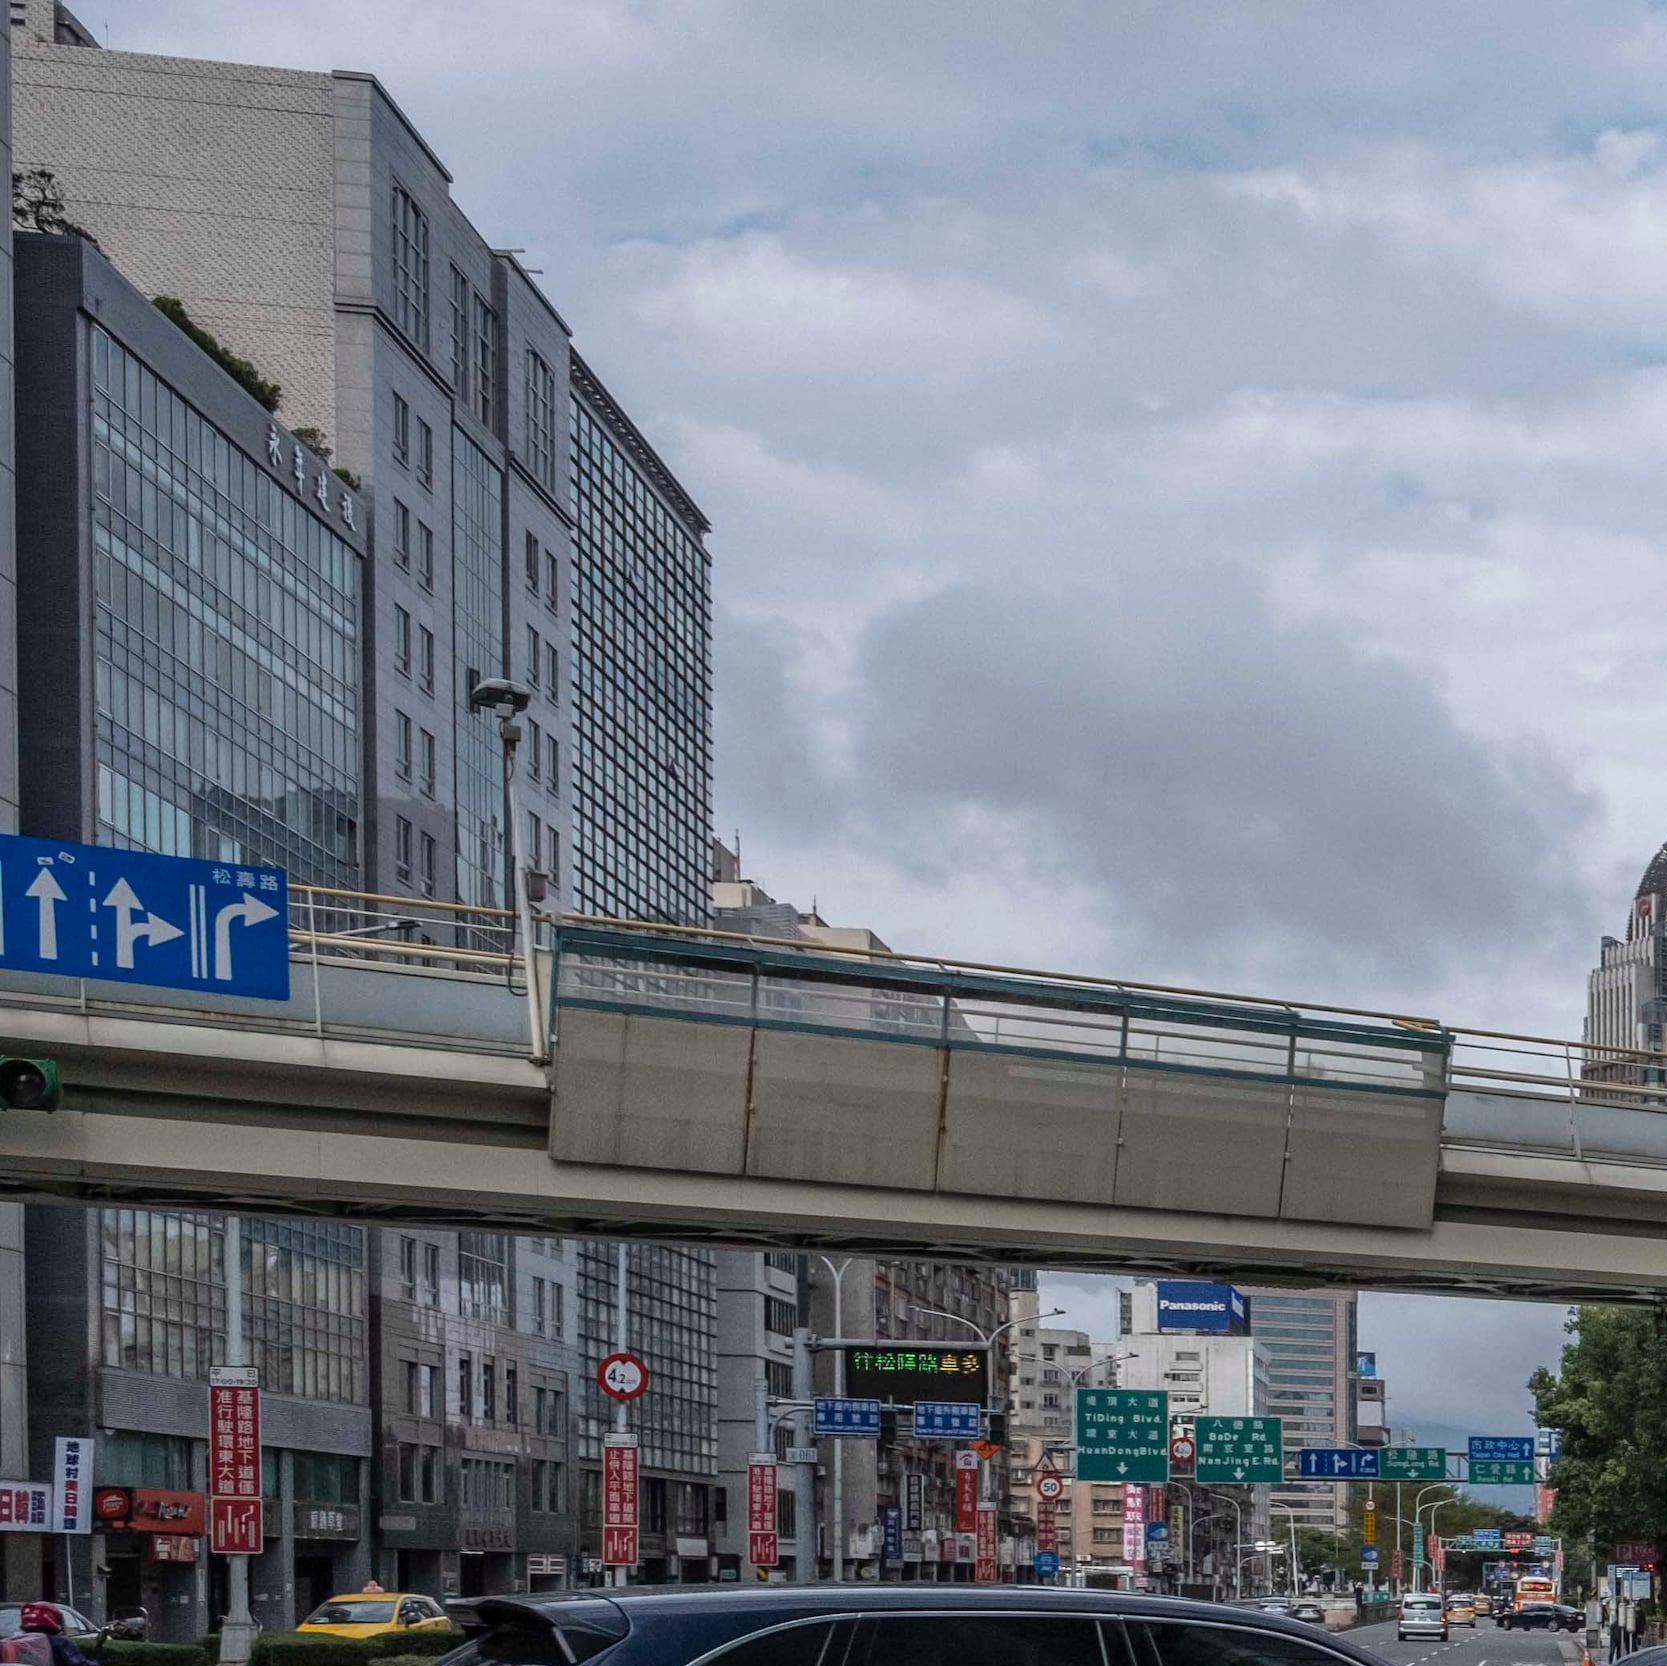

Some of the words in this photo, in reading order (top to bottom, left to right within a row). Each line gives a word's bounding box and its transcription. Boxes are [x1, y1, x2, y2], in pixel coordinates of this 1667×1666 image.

[212, 868, 279, 891] 松壽路
[1160, 1300, 1226, 1311] Panasonic
[1471, 1440, 1520, 1451] 市政中心
[1043, 1483, 1057, 1492] 50
